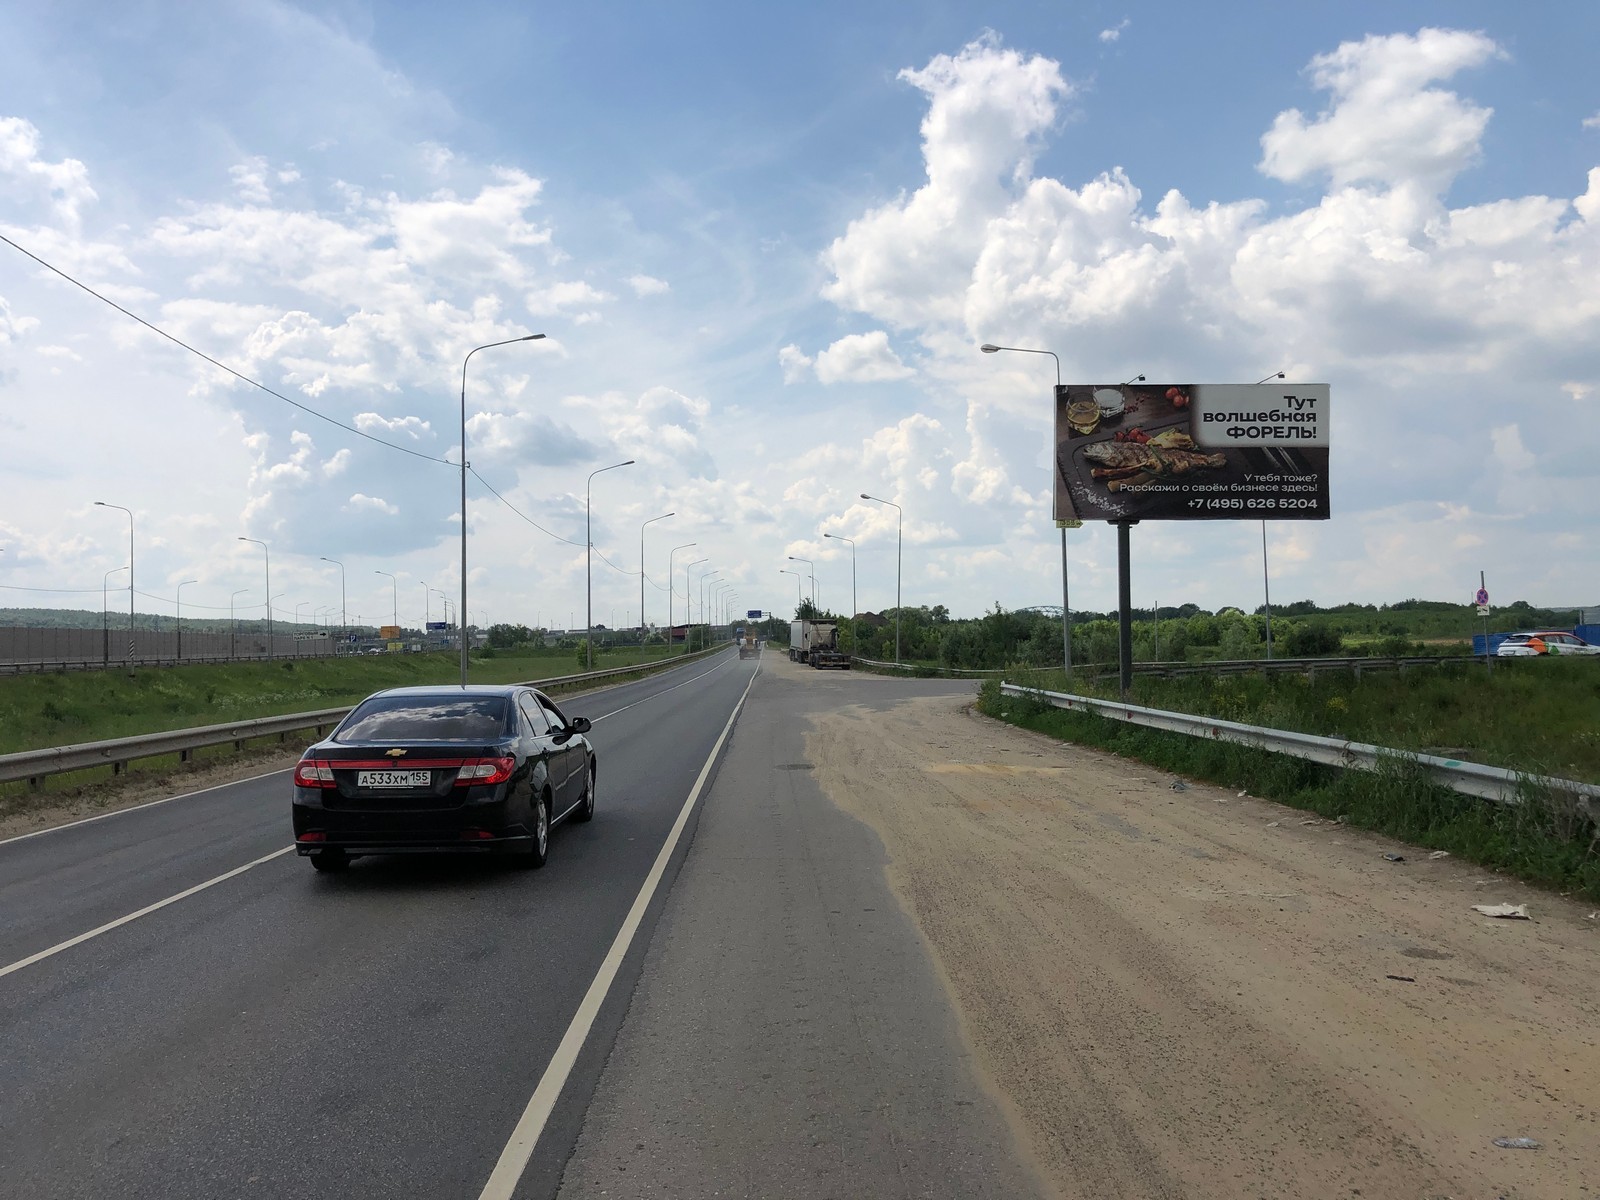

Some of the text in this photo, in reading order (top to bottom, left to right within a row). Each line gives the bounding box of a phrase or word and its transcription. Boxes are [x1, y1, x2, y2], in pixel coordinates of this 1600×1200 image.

[1284, 396, 1316, 410] Тут
[1203, 410, 1316, 422] волшебная
[1226, 426, 1316, 438] ФОРЕЛЬ!
[1192, 484, 1228, 492] своём
[1230, 484, 1278, 492] бизнесе
[1282, 484, 1318, 492] здесь!
[1188, 498, 1318, 510] +7 (495) 626 5204
